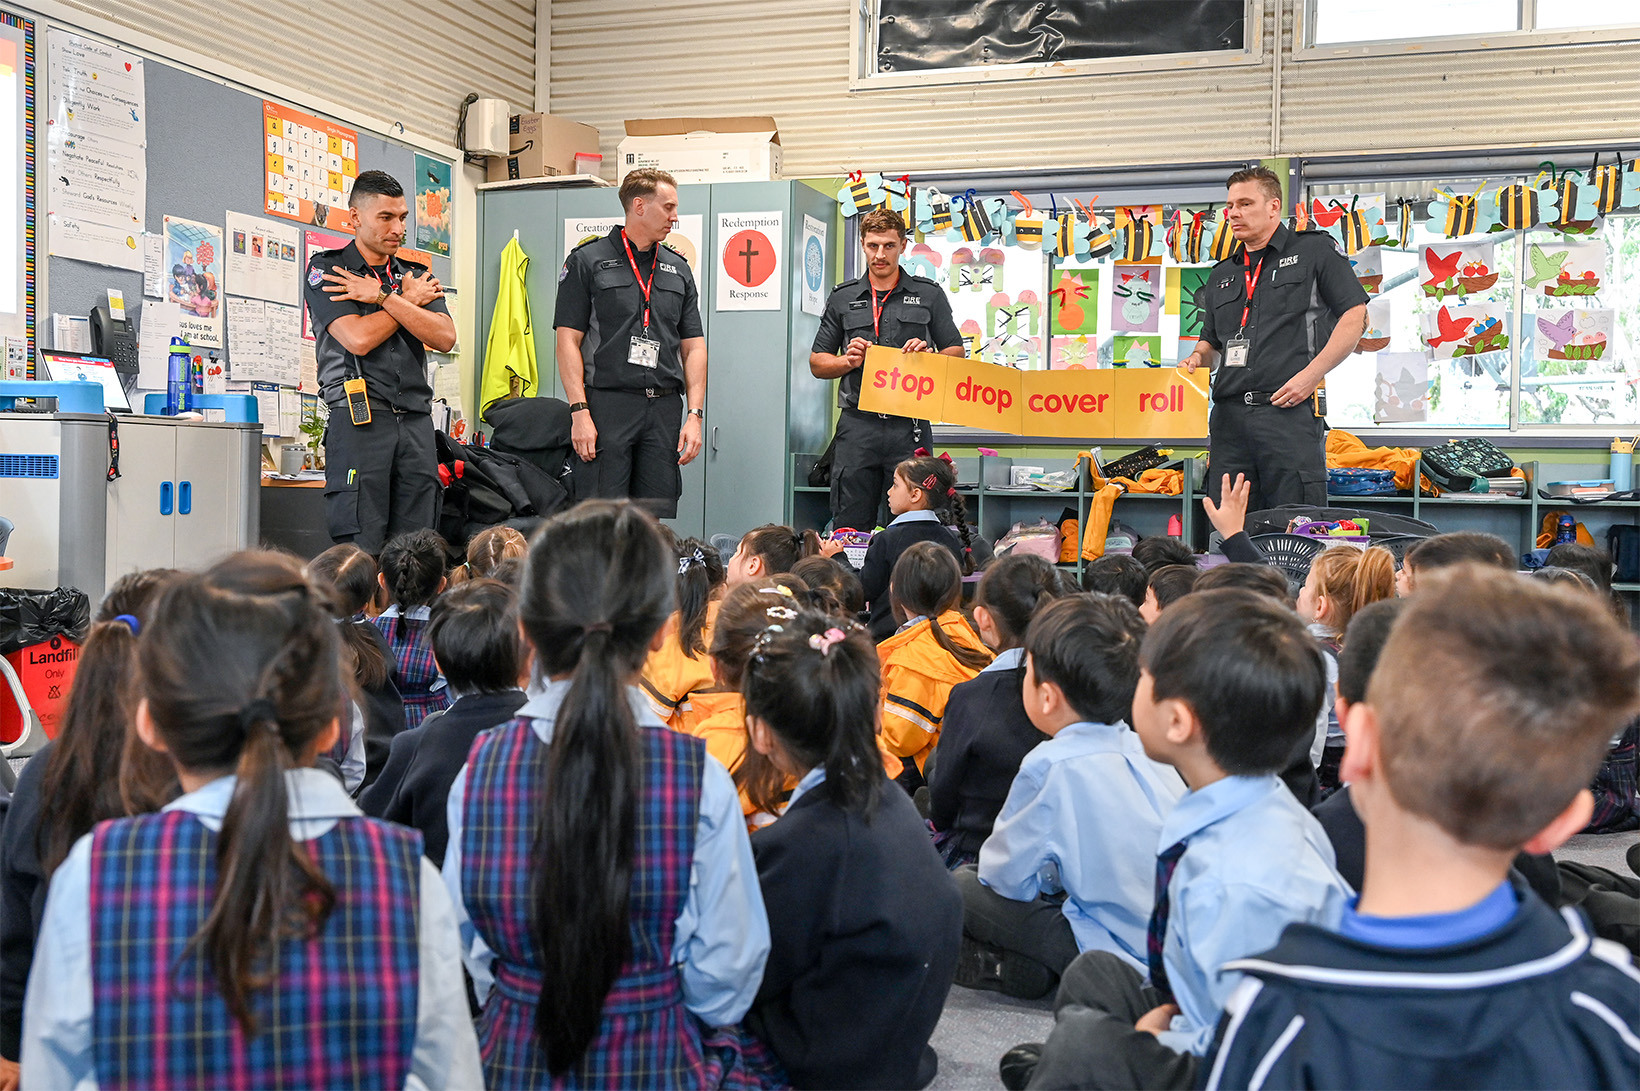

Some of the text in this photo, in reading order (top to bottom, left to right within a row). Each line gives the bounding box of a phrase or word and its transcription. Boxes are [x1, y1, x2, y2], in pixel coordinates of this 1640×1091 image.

[73, 49, 85, 58] Love
[86, 87, 103, 97] Choices
[111, 94, 139, 107] Consequences
[87, 102, 100, 111] Work
[523, 125, 537, 134] Eggs
[86, 155, 104, 166] Peaceful
[63, 166, 75, 174] Treat
[77, 170, 92, 178] Others
[94, 173, 120, 188] Respectfully
[62, 188, 81, 197] Steward
[97, 195, 117, 206] Resources
[63, 221, 80, 232] Safety
[576, 222, 613, 232] Creation
[721, 217, 779, 229] Redemption
[1279, 255, 1299, 264] FIRE
[729, 289, 769, 301] Response
[189, 322, 202, 330] loves
[200, 333, 219, 342] school.
[873, 366, 1184, 414] stop drop cover roll
[30, 648, 79, 664] Landfill
[45, 669, 64, 679] Only
